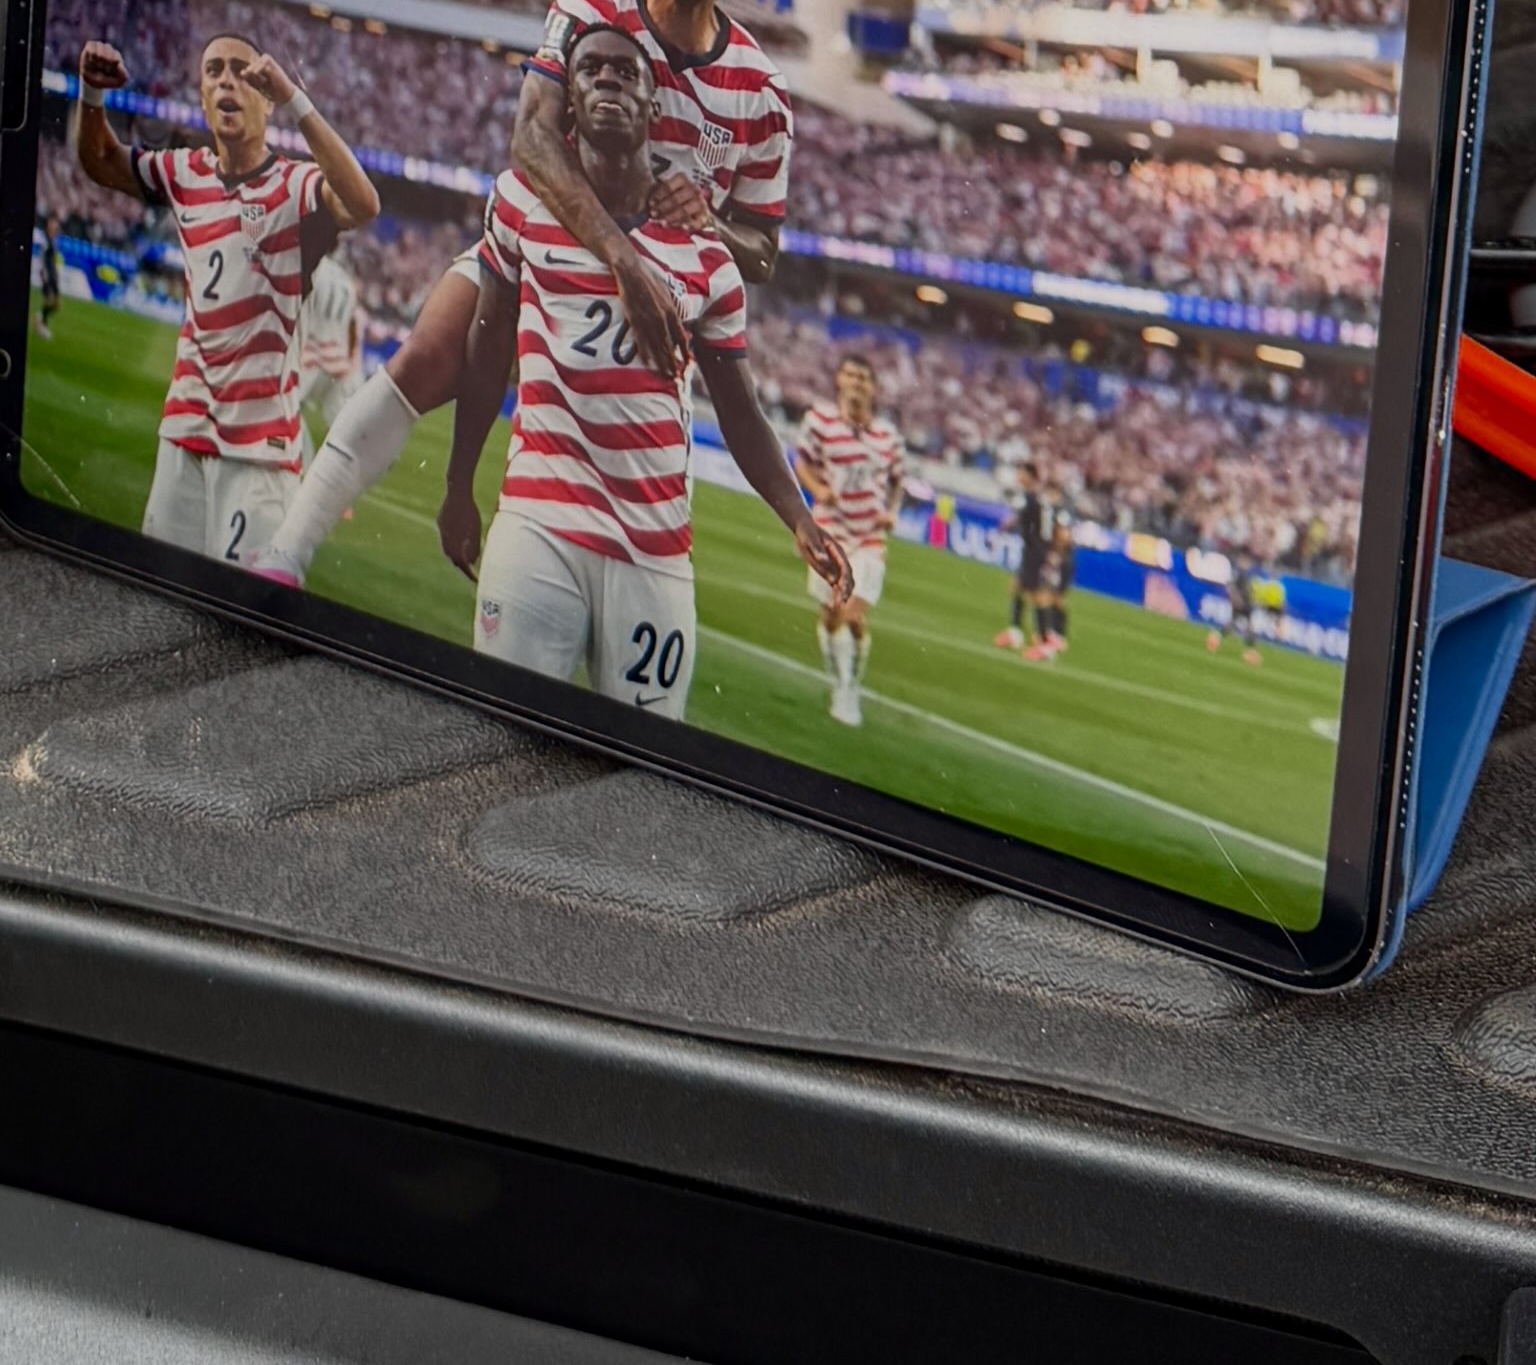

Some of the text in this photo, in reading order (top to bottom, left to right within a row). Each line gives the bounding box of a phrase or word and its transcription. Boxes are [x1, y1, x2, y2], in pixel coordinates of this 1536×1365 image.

[702, 122, 732, 145] USA
[241, 205, 265, 222] USA
[202, 248, 224, 301] 2
[224, 509, 247, 561] 2
[625, 620, 685, 689] 20
